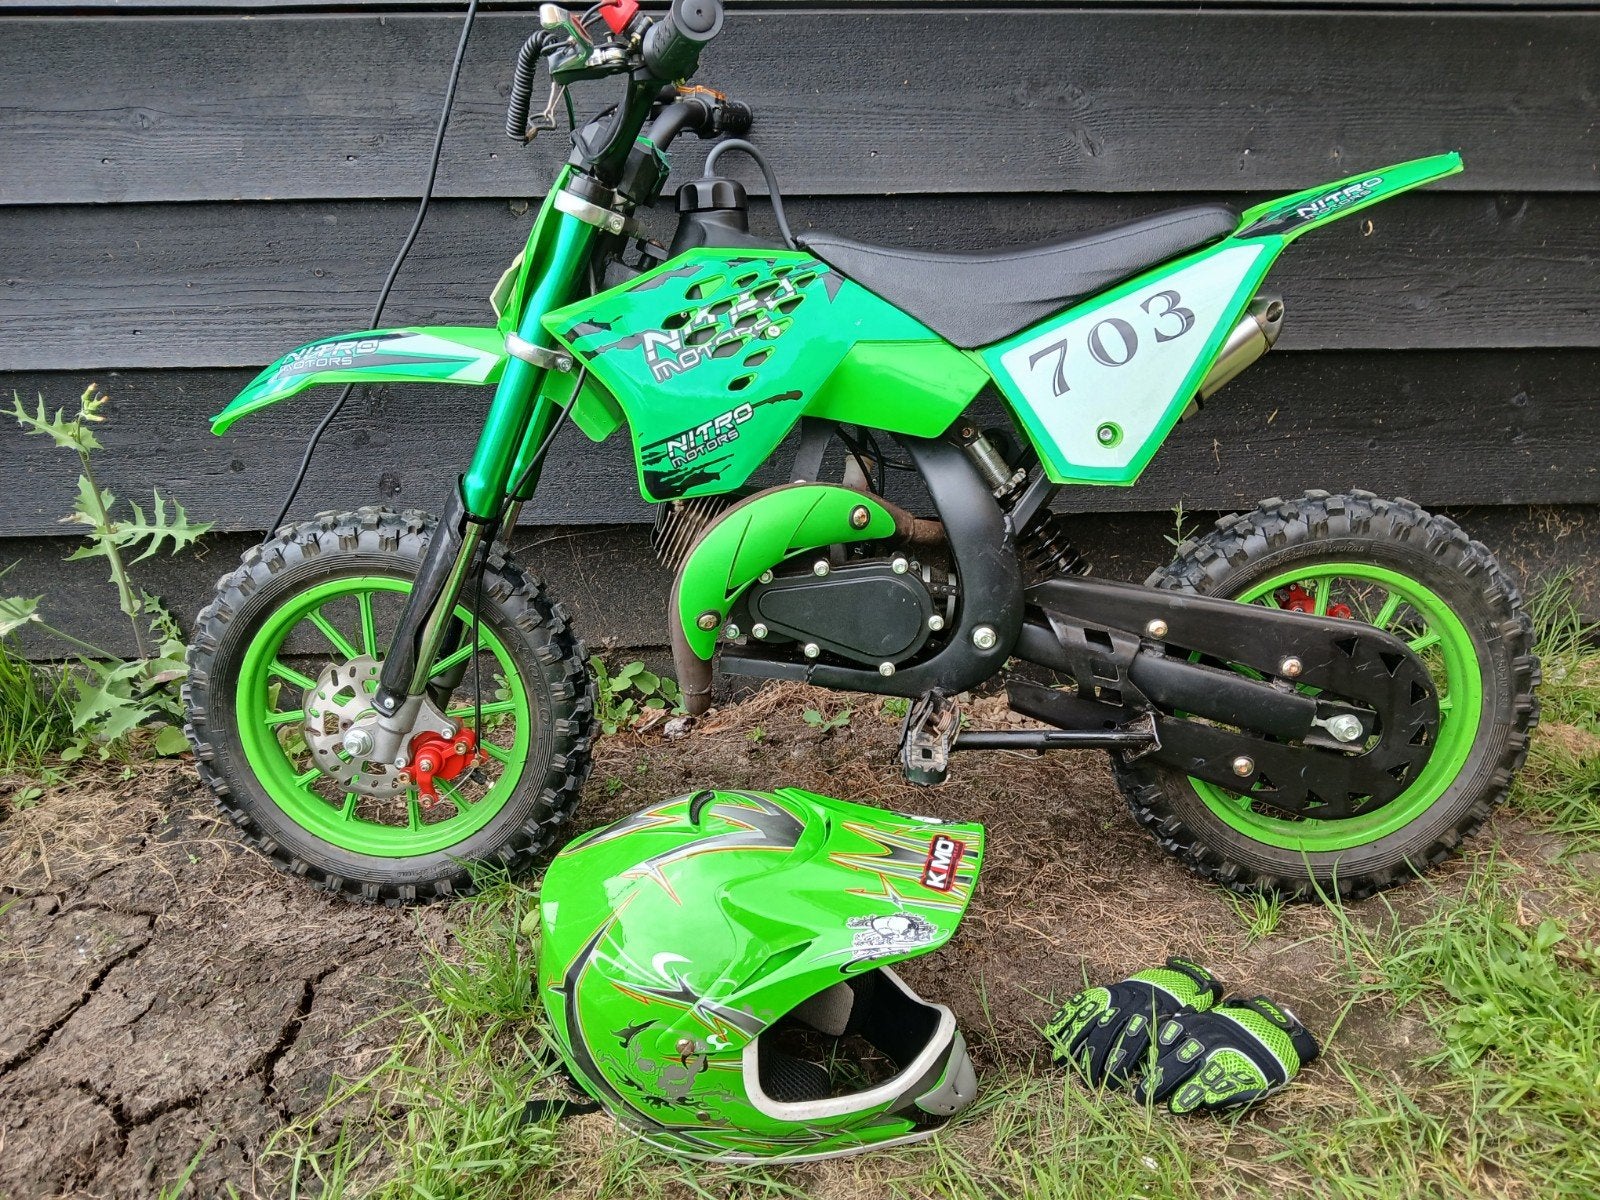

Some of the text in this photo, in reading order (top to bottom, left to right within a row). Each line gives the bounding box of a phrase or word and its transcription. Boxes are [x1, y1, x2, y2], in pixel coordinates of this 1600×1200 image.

[1297, 177, 1383, 217] NITRO
[281, 339, 379, 365] NITRO
[1028, 289, 1196, 398] 703
[280, 356, 353, 373] MOTORS
[667, 402, 754, 459] NITRO
[671, 428, 740, 469] MOTORS
